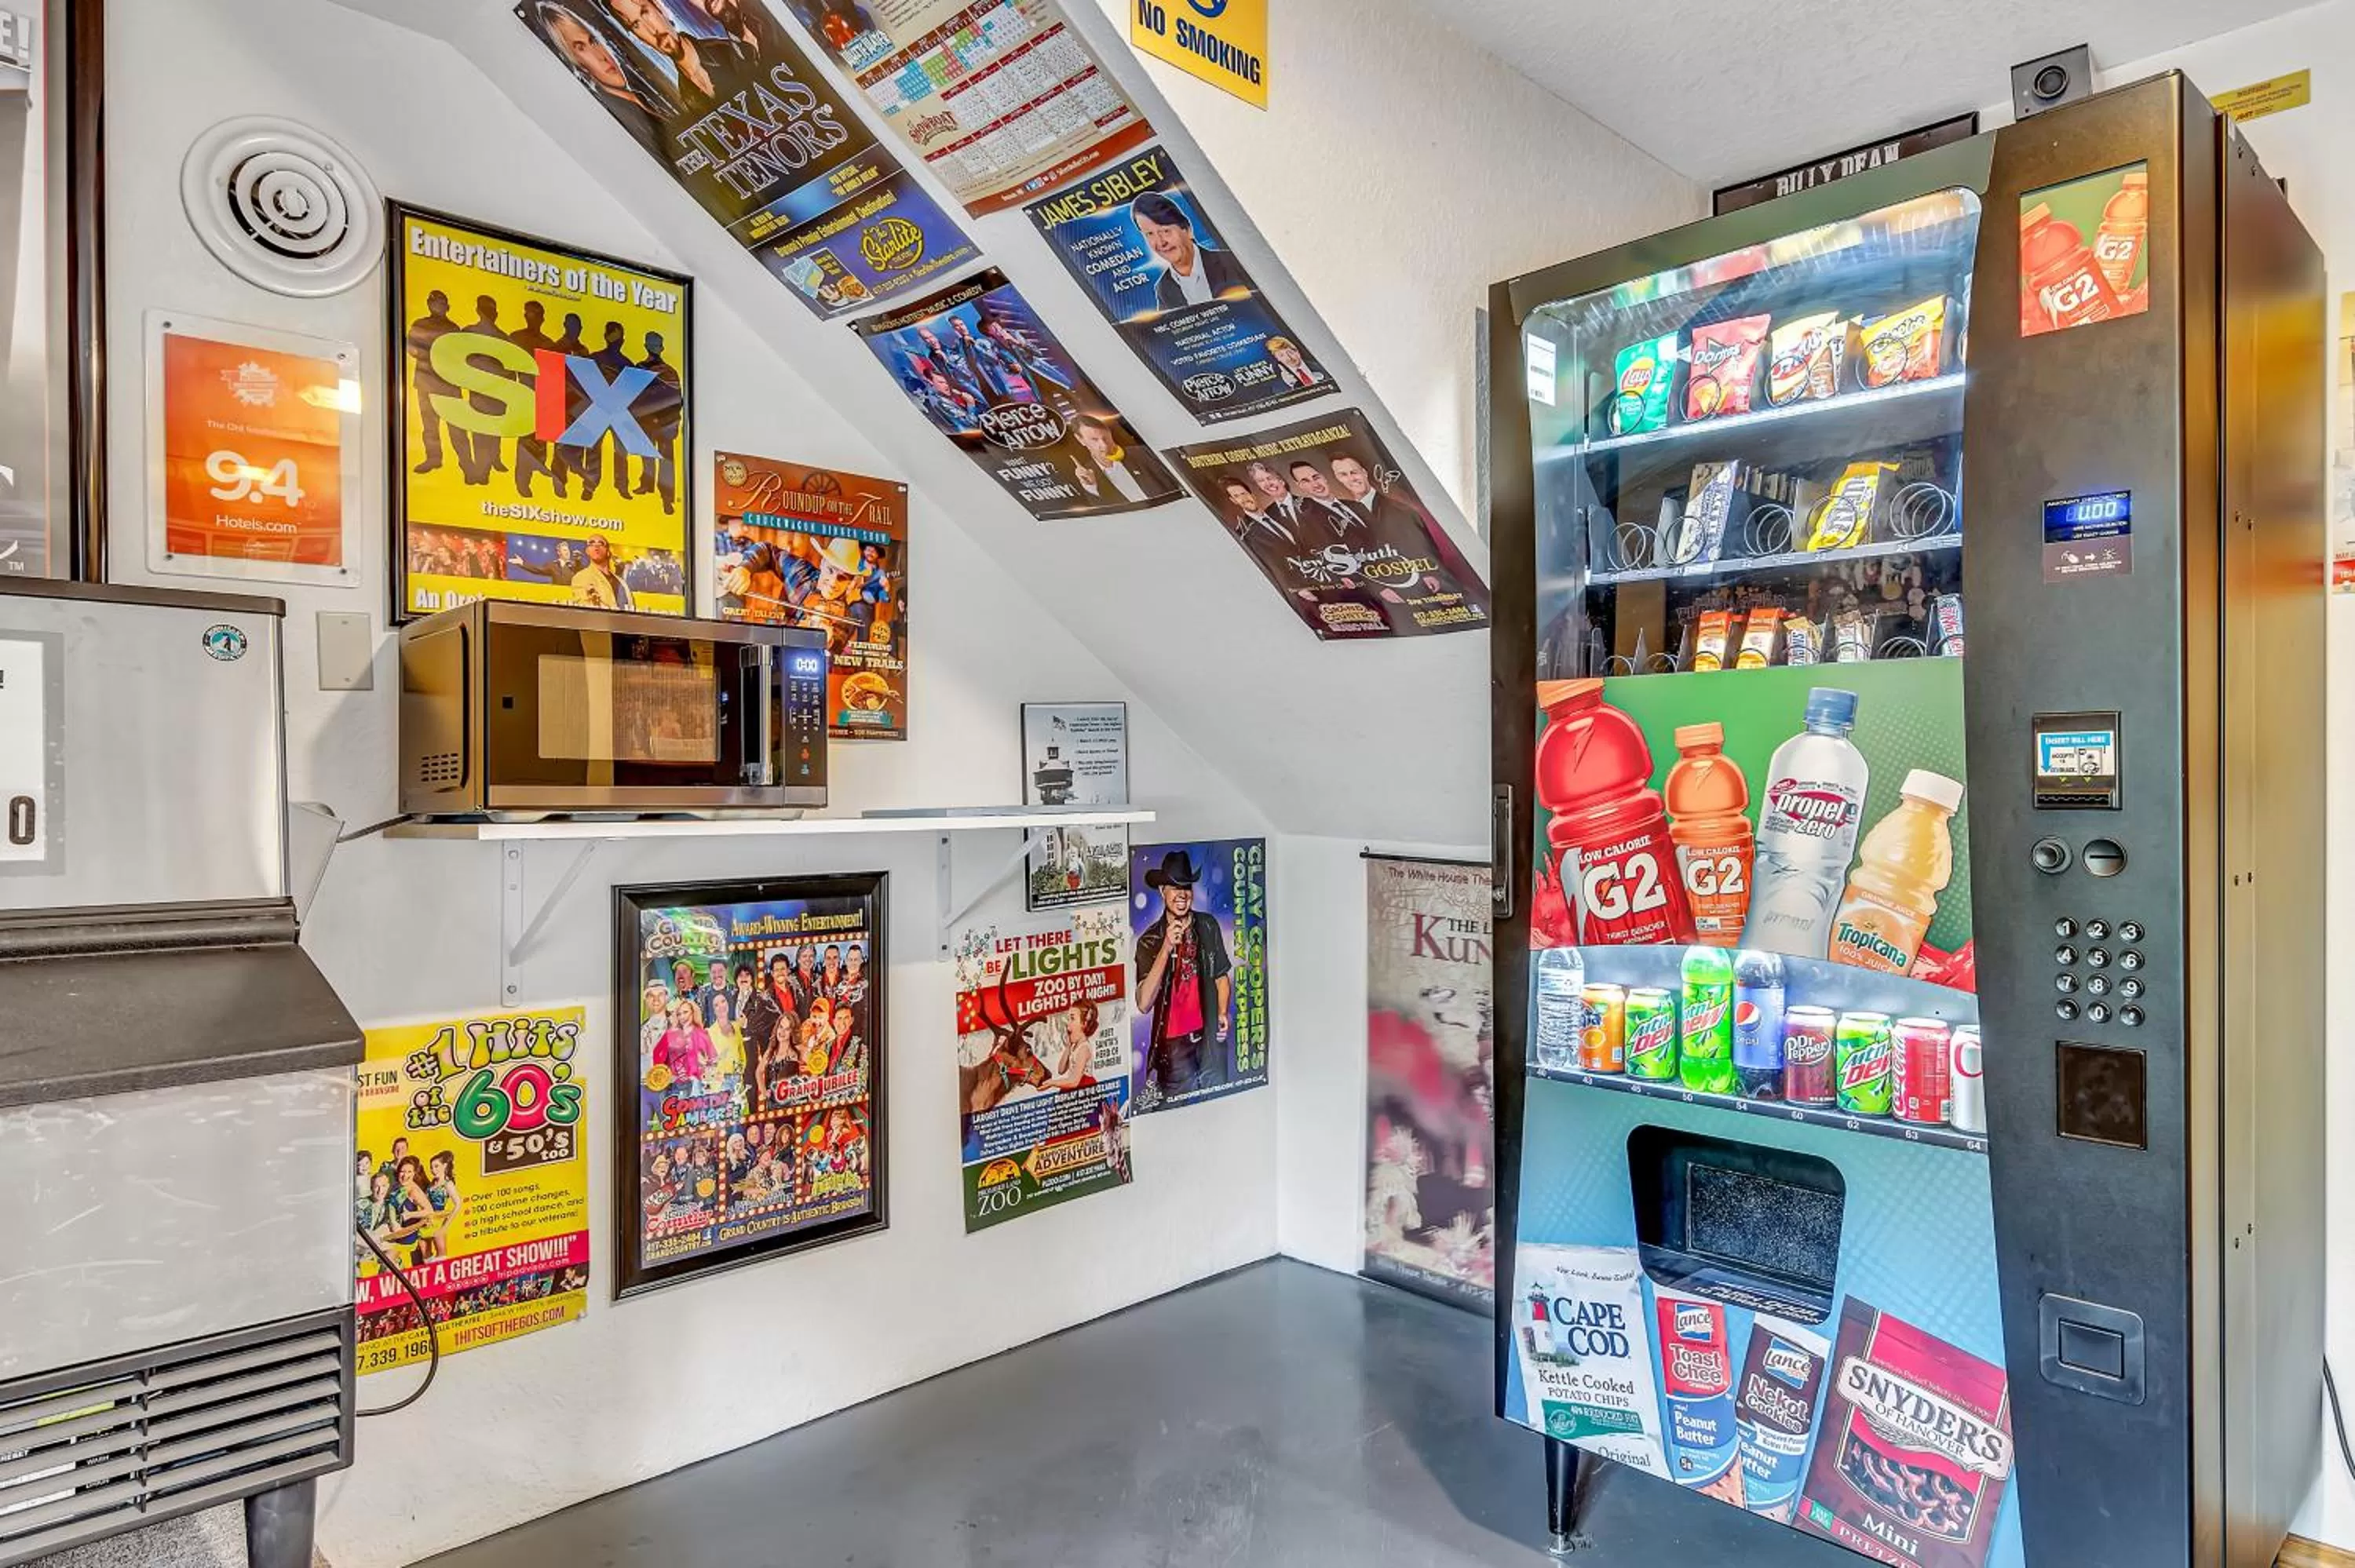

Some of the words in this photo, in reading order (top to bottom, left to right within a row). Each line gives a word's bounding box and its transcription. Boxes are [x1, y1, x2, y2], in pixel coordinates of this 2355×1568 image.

[1137, 2, 1167, 37] NO
[1175, 18, 1262, 87] SMOKING
[676, 62, 818, 170] TEXAS
[907, 110, 960, 144] SHOWBOAT
[675, 148, 709, 176] THE
[713, 105, 849, 200] TENORS
[1036, 189, 1098, 231] JAMES
[1098, 155, 1167, 207] SIBLEY
[864, 221, 922, 272] Starlite
[1069, 224, 1124, 253] NATIONALLY
[1086, 240, 1123, 261] KNOWN
[2100, 239, 2134, 261] G2
[411, 225, 560, 285] Entertainers
[564, 266, 589, 294] of
[591, 270, 627, 302] the
[631, 279, 678, 315] Year
[1085, 246, 1145, 276] COMEDIAN
[1111, 264, 1132, 279] AND
[952, 283, 984, 303] COMEDY
[1112, 272, 1151, 294] ACTOR
[2052, 273, 2100, 312] G2
[429, 331, 664, 459] SIX
[1252, 441, 1283, 458] MUSIC
[1277, 424, 1353, 453] EXTRAVAGANZA!
[206, 449, 305, 508] 9.4
[996, 461, 1058, 482] FUNNY?
[728, 470, 825, 516] ROUNDUP
[1018, 483, 1081, 502] FUNNY!
[480, 500, 625, 531] theSIXshow.com
[838, 501, 854, 516] THE
[838, 491, 893, 527] TRAIL
[215, 513, 299, 534] Hotels.com
[1286, 552, 1327, 574] New
[1364, 556, 1439, 580] GOSPEL
[414, 588, 440, 610] An
[847, 640, 893, 651] FEATURING
[833, 655, 864, 667] NEW
[865, 657, 904, 670] TRAILS
[1776, 793, 1846, 822] propel
[1795, 818, 1836, 840] zero
[1579, 850, 1603, 864] LOW
[1604, 834, 1652, 857] CALORIE
[1247, 844, 1265, 920] CLAY
[1387, 866, 1405, 879] The
[1408, 868, 1437, 882] White
[1437, 873, 1469, 885] House
[1583, 851, 1667, 921] G2
[1687, 855, 1744, 896] G2
[1232, 846, 1248, 961] COUNTRY
[1447, 917, 1480, 934] THE
[2061, 921, 2070, 934] 1
[2094, 923, 2104, 936] 2
[2127, 925, 2137, 939] 3
[995, 936, 1022, 954] LET
[1026, 929, 1073, 949] THERE
[1838, 922, 1908, 968] Tropicana
[985, 960, 1002, 974] BE
[1012, 938, 1117, 980] LIGHTS
[2061, 949, 2071, 962] 4
[2094, 951, 2104, 965] 5
[2127, 954, 2137, 968] 6
[1033, 977, 1066, 997] ZOO
[1067, 975, 1083, 990] BY
[1083, 972, 1106, 987] DAY!
[2062, 976, 2072, 990] 7
[2094, 979, 2104, 992] 8
[2127, 982, 2137, 995] 9
[1017, 994, 1068, 1017] LIGHTS
[1070, 990, 1084, 1005] BY
[1248, 924, 1267, 1071] COOPER'S
[1235, 965, 1251, 1074] EXPRESS
[2095, 1007, 2104, 1019] 0
[406, 1027, 466, 1083] #1
[467, 1019, 579, 1070] Hits
[1786, 1037, 1828, 1060] Pepper
[1797, 1034, 1816, 1048] Dr
[373, 1070, 398, 1085] FUN
[775, 1078, 817, 1102] GRAND
[812, 1069, 859, 1101] JUBILEE
[408, 1104, 452, 1129] the
[453, 1062, 582, 1140] 60's
[413, 1086, 444, 1107] of
[973, 1110, 1000, 1124] LARGEST
[1000, 1105, 1019, 1118] DRIVE
[1020, 1101, 1037, 1113] THRU
[1036, 1097, 1053, 1110] LIGHT
[1054, 1090, 1079, 1104] DISPLAY
[1736, 1101, 1748, 1111] 54
[1847, 1120, 1860, 1129] 62
[1905, 1129, 1919, 1140] 63
[1966, 1140, 1981, 1150] 64
[487, 1140, 504, 1154] &
[541, 1147, 570, 1161] too
[1035, 1144, 1106, 1172] ADVENTURE
[470, 1191, 494, 1202] Over
[496, 1187, 511, 1198] 100
[472, 1205, 487, 1214] 100
[489, 1197, 528, 1211] costume
[529, 1189, 571, 1203] changes,
[978, 1187, 1021, 1216] ZOO
[480, 1212, 500, 1225] high
[502, 1206, 531, 1220] school
[533, 1200, 565, 1213] dance,
[567, 1197, 585, 1206] and
[718, 1225, 747, 1242] GRAND
[746, 1217, 781, 1235] COUNTRY
[790, 1204, 831, 1223] AUTHENTIC
[479, 1224, 508, 1237] tribute
[509, 1220, 520, 1229] to
[520, 1219, 536, 1227] our
[378, 1268, 429, 1300] WHAT
[430, 1264, 447, 1286] A
[450, 1250, 504, 1282] GREAT
[451, 1316, 481, 1329] THEATRE
[1553, 1296, 1627, 1331] CAPE
[1675, 1311, 1711, 1332] Lance
[1568, 1326, 1630, 1359] COD
[1668, 1343, 1722, 1369] Toast
[1763, 1350, 1812, 1373] Lance
[1539, 1369, 1579, 1387] Kettle
[1582, 1373, 1634, 1395] Cooked
[1672, 1361, 1723, 1386] Chee
[1547, 1387, 1592, 1403] POTATO
[1594, 1393, 1630, 1407] CHIPS
[1750, 1373, 1809, 1420] Nekot
[1674, 1410, 1718, 1433] Peanut
[1745, 1393, 1803, 1434] Cookies
[1848, 1364, 2003, 1462] SNYDER'S
[1676, 1425, 1716, 1446] Butter
[1875, 1401, 1893, 1420] OF
[1893, 1411, 1965, 1457] HANOVER
[1597, 1446, 1652, 1468] Original
[1741, 1441, 1777, 1468] eanut
[1861, 1512, 1919, 1557] Mini
